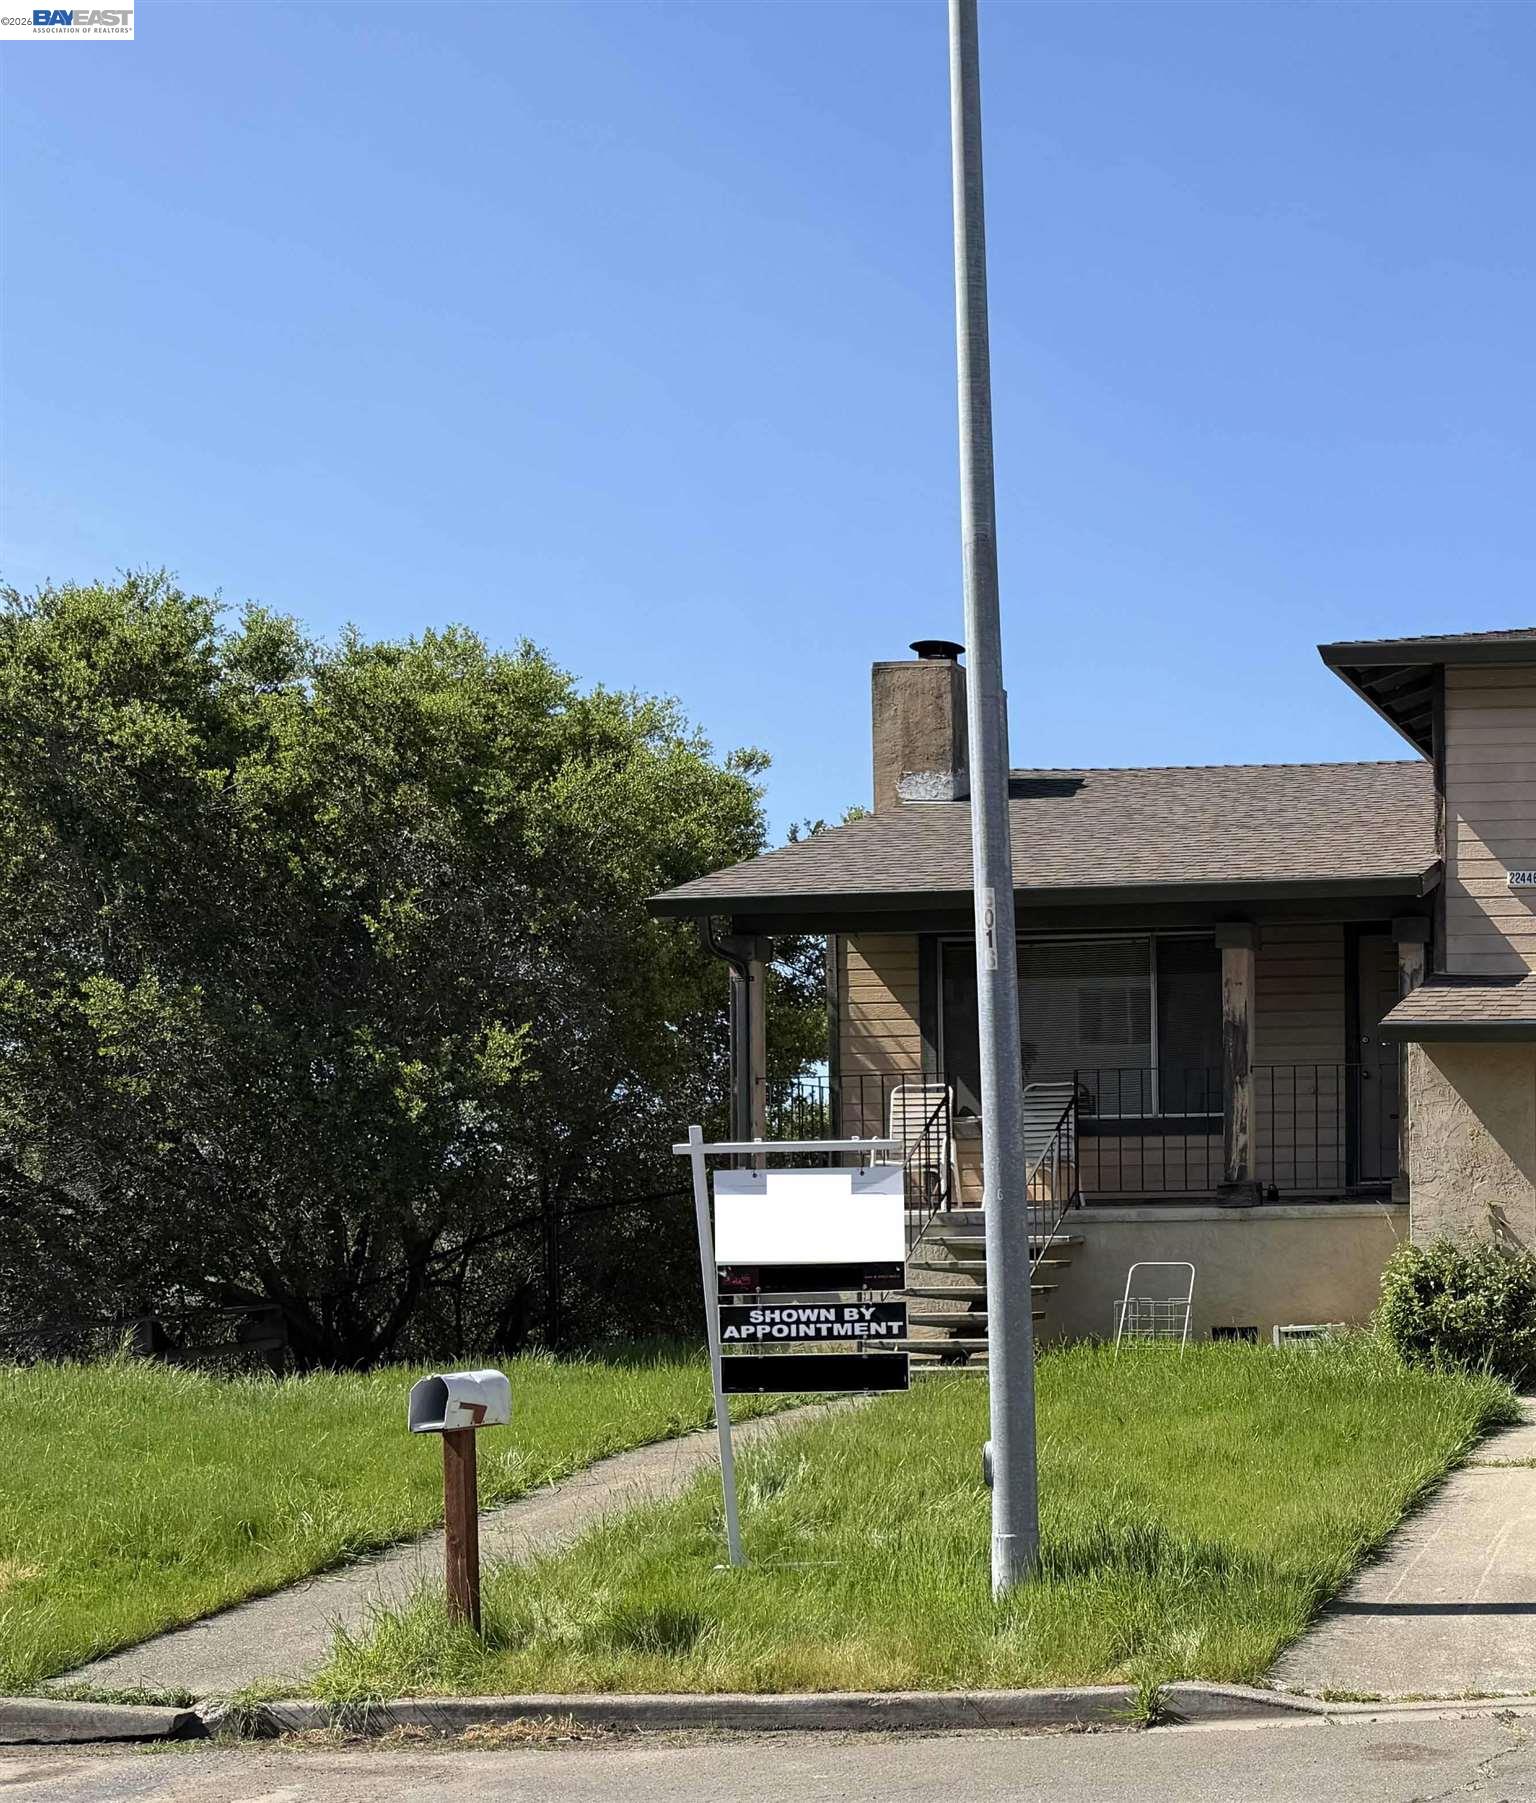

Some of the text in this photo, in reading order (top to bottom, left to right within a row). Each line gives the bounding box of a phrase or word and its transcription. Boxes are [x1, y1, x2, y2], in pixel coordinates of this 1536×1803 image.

[750, 1307, 876, 1323] SHOWN BY
[722, 1322, 903, 1339] APPOINTMENT
